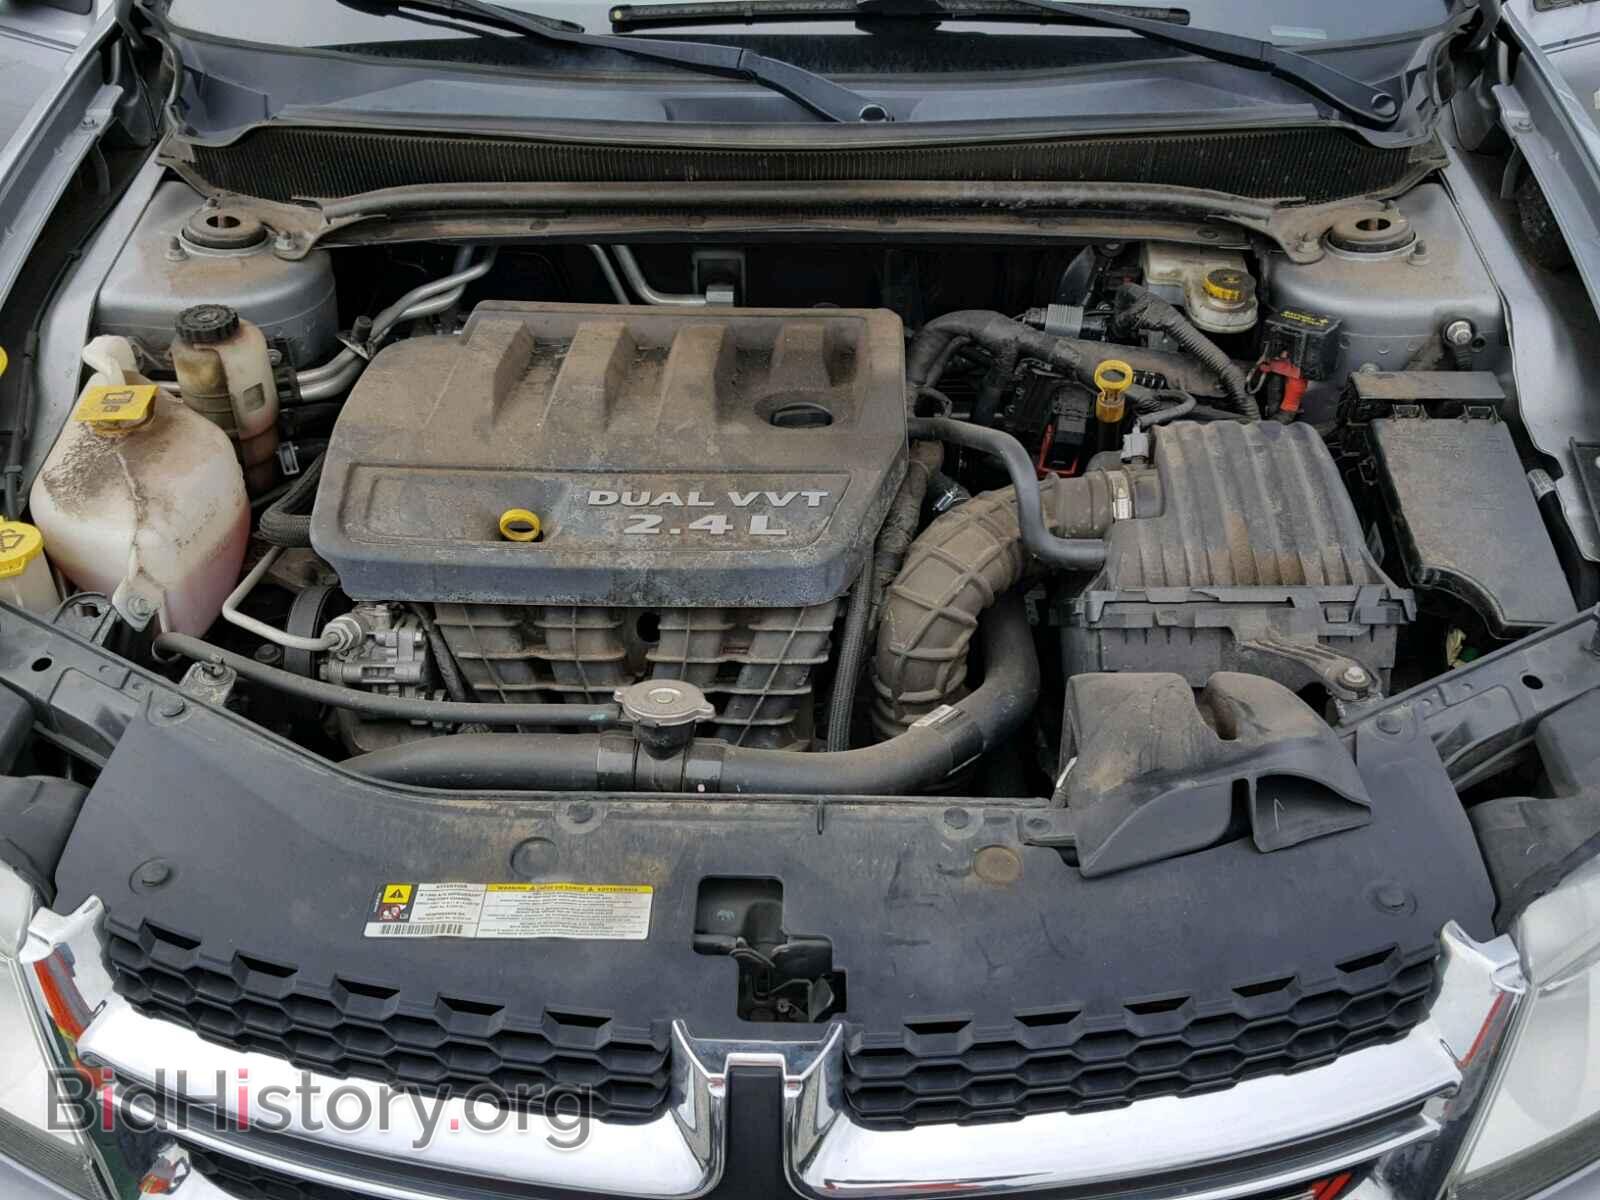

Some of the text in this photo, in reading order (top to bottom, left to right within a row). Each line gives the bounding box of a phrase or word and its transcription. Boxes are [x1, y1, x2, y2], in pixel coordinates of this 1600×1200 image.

[587, 490, 829, 507] DUAL VVT
[623, 514, 787, 535] 2.4 L
